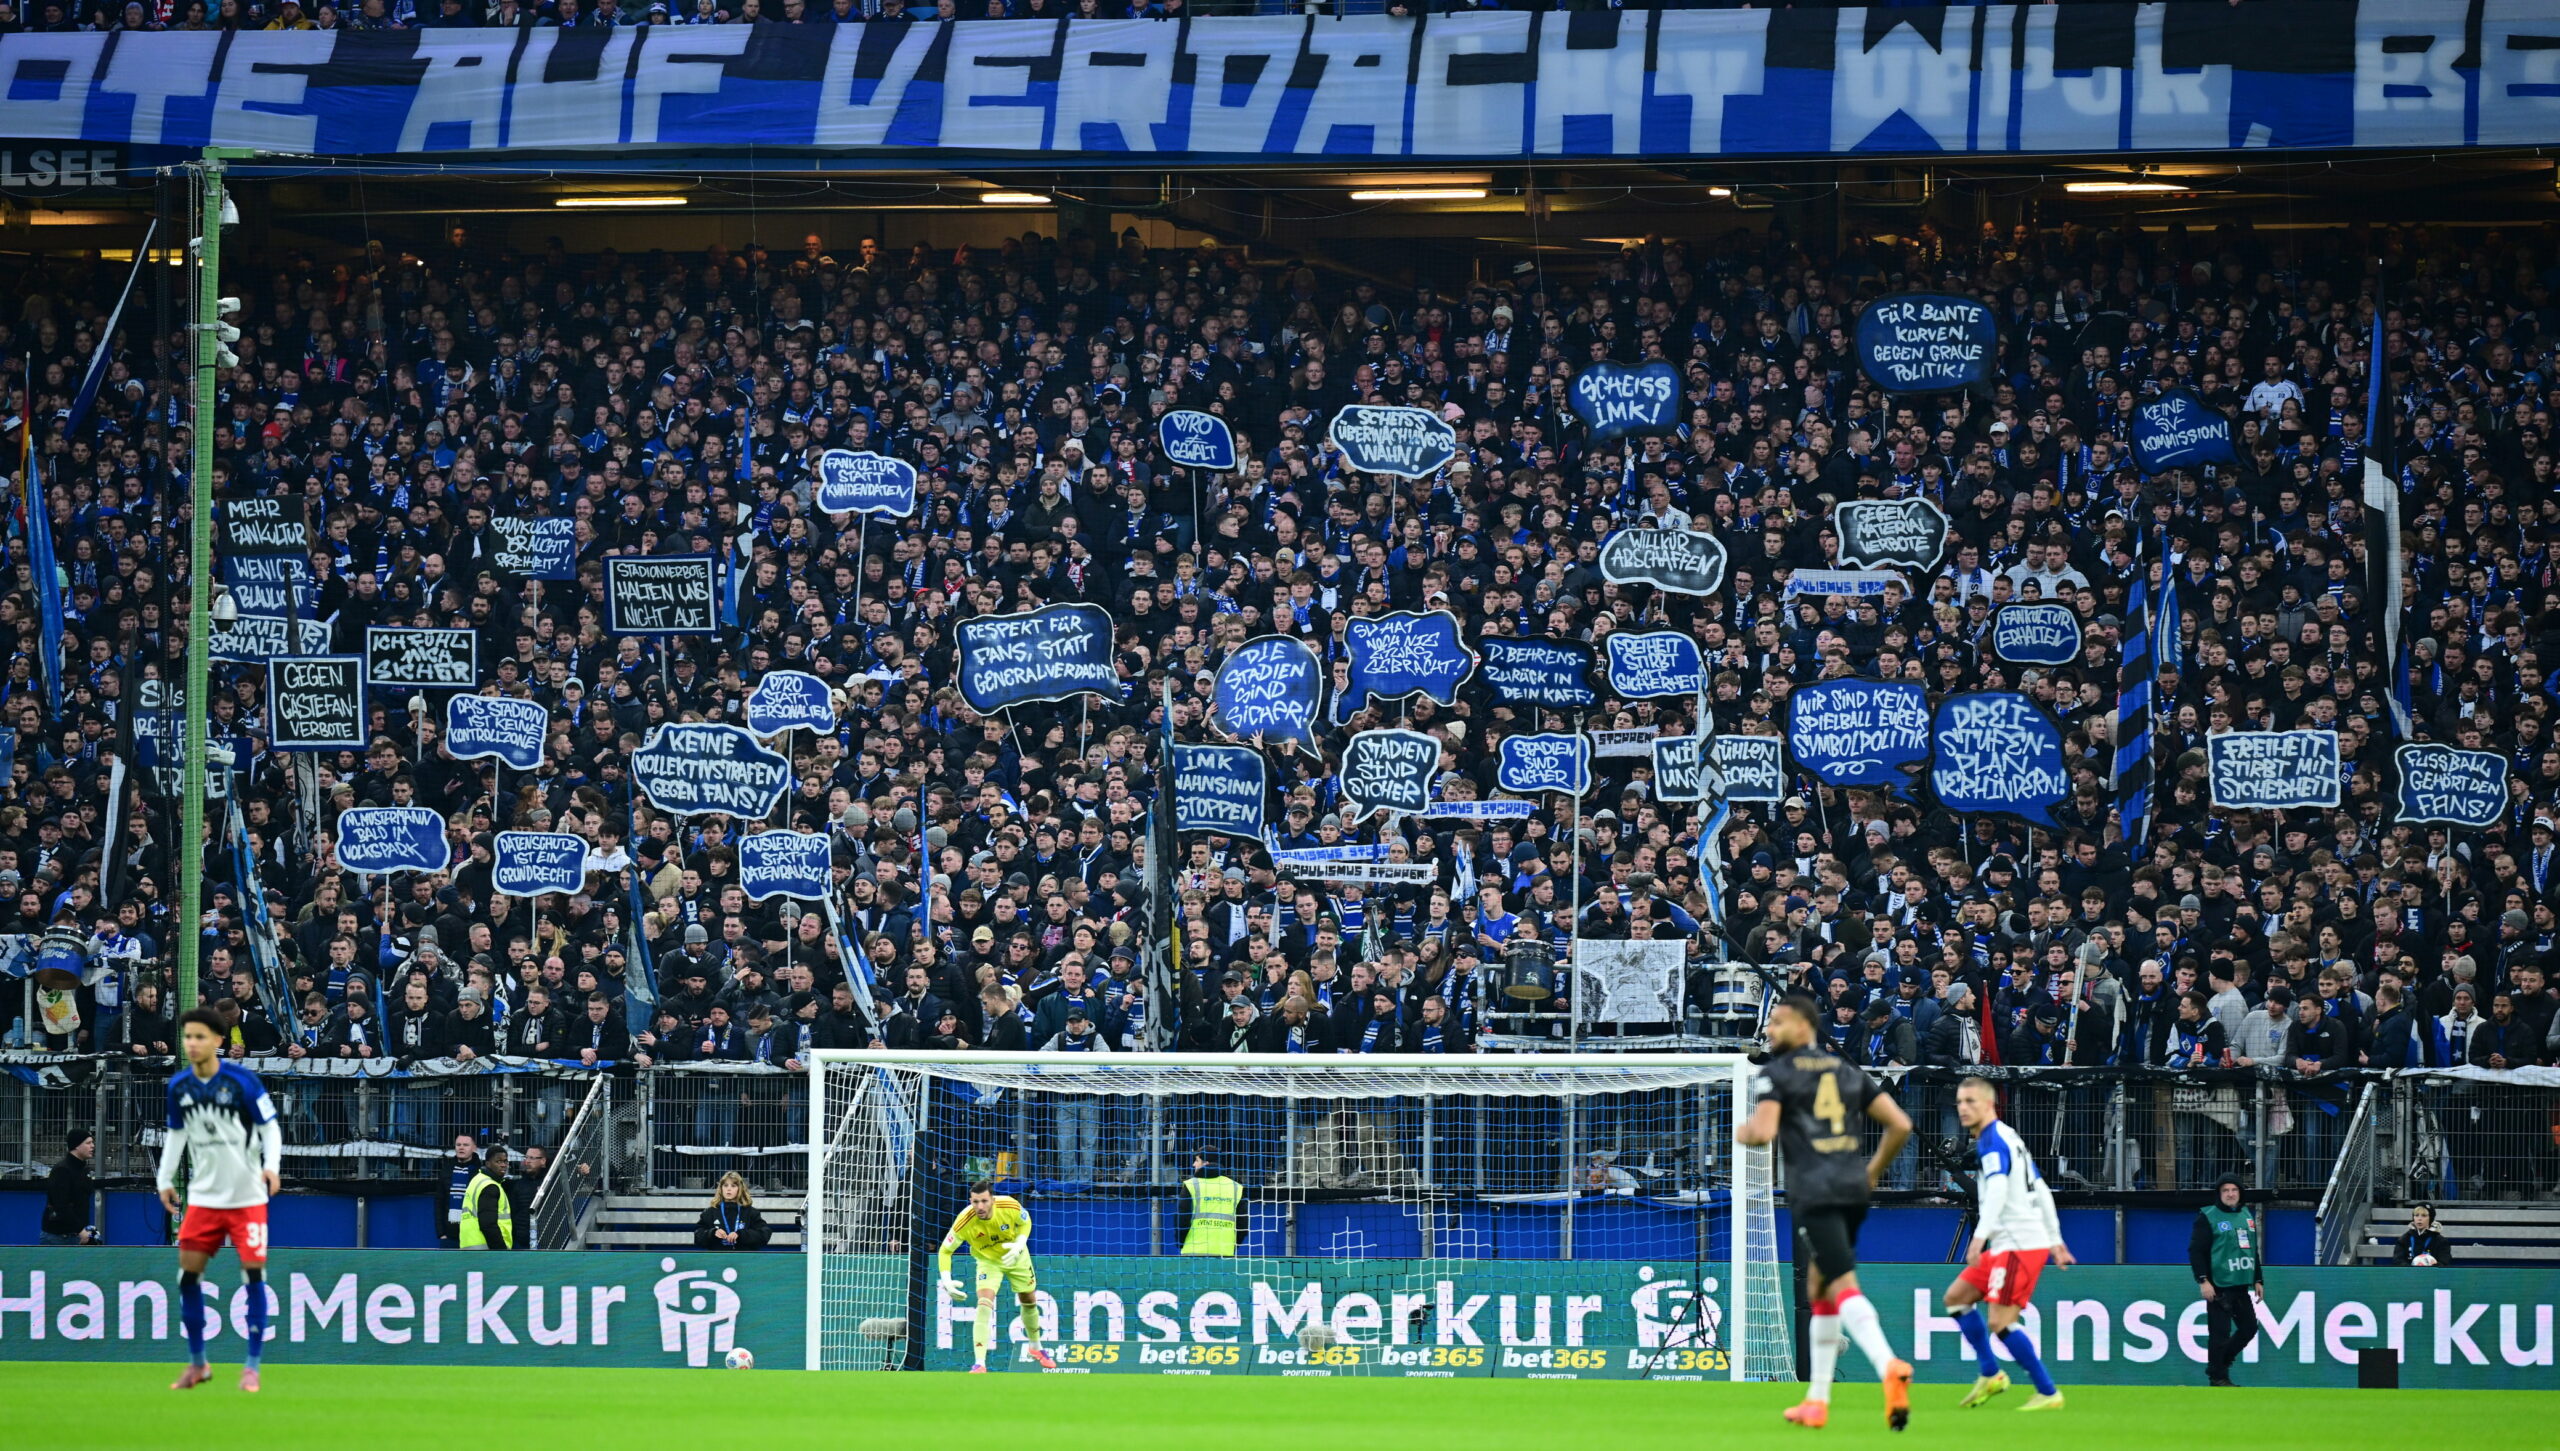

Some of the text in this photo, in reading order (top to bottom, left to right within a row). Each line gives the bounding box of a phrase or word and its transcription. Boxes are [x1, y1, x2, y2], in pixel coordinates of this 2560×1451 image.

[397, 24, 752, 152] AUF
[814, 8, 1770, 154] VERDACHT
[1877, 302, 1982, 324] FÜR BUNTE
[1874, 344, 1982, 361] GEGEN GRAUE
[1888, 362, 1965, 382] POLITIK!
[1579, 374, 1671, 402] SCHEISS
[1357, 409, 1428, 432] SCHEISS
[2142, 398, 2187, 421] KEINE
[1172, 414, 1213, 435] PYRO
[2140, 421, 2229, 452] KOMMISSION!
[1170, 440, 1217, 461] GEWALT
[1358, 444, 1423, 472] WAHN!
[825, 457, 899, 478] FANKULTUR
[838, 470, 885, 484] STATT
[826, 484, 911, 499] KUNDENDATEN
[228, 499, 281, 519] MEHR
[1853, 502, 1919, 521] GEGEN
[229, 520, 307, 546] FANKULTUR
[490, 516, 574, 535] FANKULTUR
[1856, 518, 1934, 539] MATERIAL
[505, 535, 570, 553] BRAUCHT
[1628, 531, 1690, 554] WILLKÜR
[1860, 536, 1930, 554] VERBOTE
[617, 563, 707, 579] STADIONVERBOTE
[1611, 547, 1719, 575] ABSCHAFFEN
[617, 581, 709, 601] HALTEN UNS
[625, 605, 705, 627] NICHT AUF
[2000, 608, 2071, 631] FANKULTUR
[966, 615, 1083, 641] RESPEKT FÜR
[1354, 618, 1421, 638] SV HAT
[1999, 625, 2075, 648] ERHALTEN
[373, 632, 469, 651] ICH FÜHL
[973, 632, 1094, 666] FANS, STATT
[1366, 632, 1440, 651] NOCH NIE
[1612, 638, 1683, 656] FREIHEIT
[401, 649, 452, 664] MICH
[1239, 642, 1288, 665] DIE
[1369, 646, 1434, 660] ETWAS
[1622, 652, 1679, 671] STIRBT
[284, 663, 343, 689] GEGEN
[373, 659, 470, 681] SICHER
[974, 662, 1112, 695] GENERALVERDACHT
[1225, 661, 1307, 690] STADIEN
[1363, 658, 1466, 677] GEBRACHT!
[1484, 665, 1572, 685] ZURÜCK IN
[1636, 668, 1668, 680] MIT
[769, 675, 803, 692] PYRO
[1500, 686, 1539, 700] DEIN
[279, 692, 357, 720] GÄSTEFAN-
[761, 688, 812, 706] STATT
[457, 698, 544, 725] DAS STADION
[750, 704, 834, 721] PERSONALIEN
[1796, 707, 1930, 734] SPIELBALL EURER
[290, 721, 353, 739] VERBOTE
[468, 715, 543, 737] IST KEINE
[450, 728, 541, 750] KONTROLLZONE
[668, 730, 739, 755] KEINE
[1358, 737, 1431, 763] STADIEN
[1513, 740, 1577, 757] STADIEN
[1793, 725, 1929, 759] SYMBOLPOLITIK
[1939, 728, 2056, 757] STUFEN-
[2222, 733, 2329, 760] FREIHEIT
[636, 754, 785, 785] KOLLEKTIVSTRAFEN
[1356, 759, 1417, 780] SIND
[1523, 756, 1559, 770] SIND
[1955, 752, 2029, 777] PLAN
[2217, 755, 2334, 778] STIRBT MIT
[2404, 750, 2491, 778] FUSSBALL
[1508, 767, 1571, 788] SICHER
[2218, 775, 2336, 800] SICHERHEIT
[2410, 770, 2500, 796] GEHÖRT DEN
[650, 777, 770, 815] GEGEN FANS!
[1348, 778, 1421, 803] SICHER
[1176, 795, 1258, 824] STOPPEN
[2416, 794, 2494, 818] FANS!
[353, 826, 415, 845] BALD IM
[499, 835, 578, 854] DATENSCHUTZ
[743, 836, 828, 856] AUSVERKAUFT
[342, 840, 428, 863] VOLKSPARK
[513, 851, 569, 865] IST EIN
[761, 851, 810, 866] STATT
[499, 866, 574, 884] GRUNDRECHT
[1814, 1072, 1845, 1135] 4
[1139, 1344, 1240, 1365] bet365
[1258, 1343, 1360, 1366] bet365
[1380, 1345, 1484, 1367] bet365
[1502, 1347, 1607, 1369] bet365
[1627, 1349, 1731, 1371] bet365
